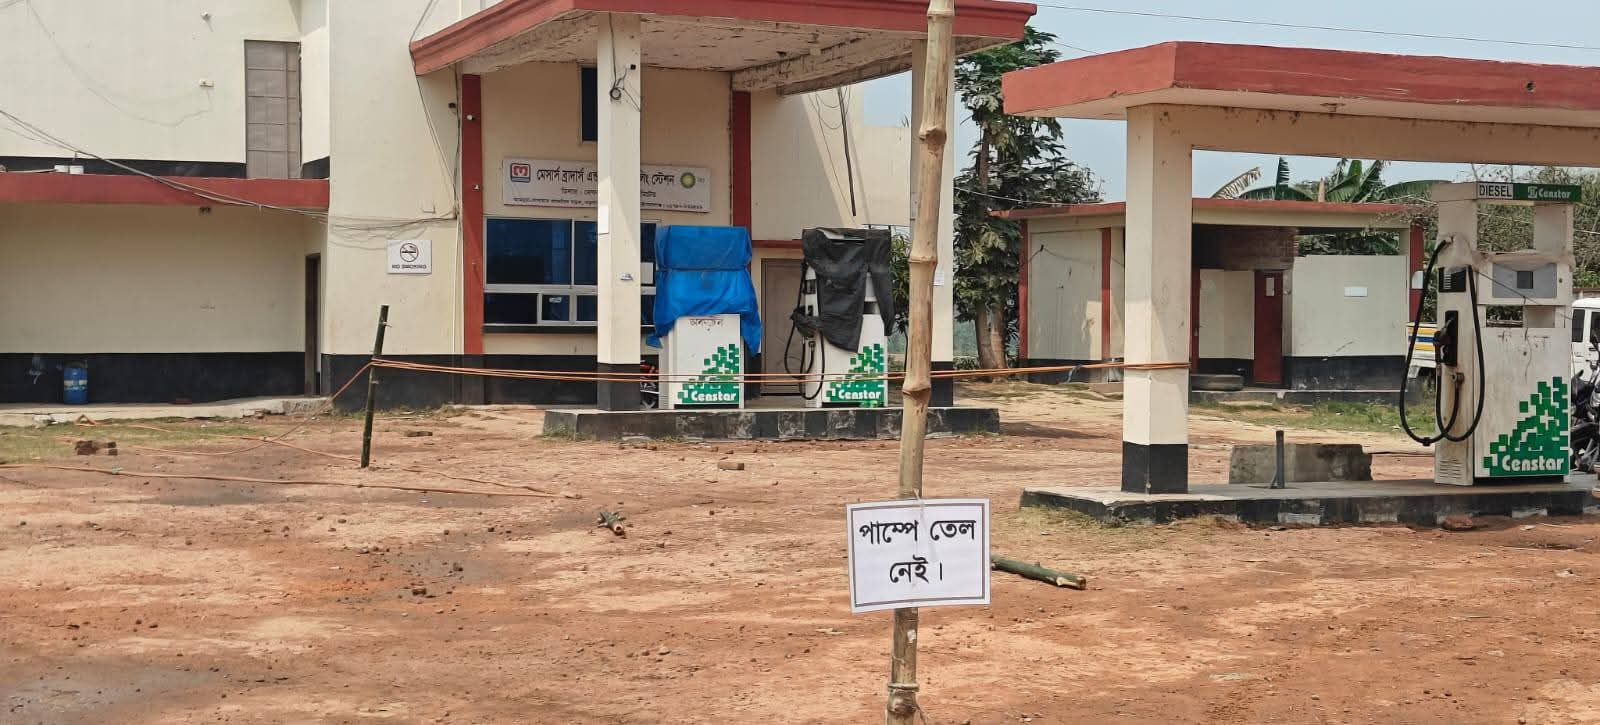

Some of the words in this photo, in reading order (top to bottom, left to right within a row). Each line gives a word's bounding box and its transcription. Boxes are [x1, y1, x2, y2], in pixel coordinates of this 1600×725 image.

[537, 166, 560, 182] মেসার্স
[652, 171, 675, 185] স্টেশন
[1479, 184, 1513, 198] DIESEL
[1539, 187, 1571, 199] Censtar
[691, 390, 737, 402] Censtar
[838, 389, 882, 400] Censtar
[1501, 454, 1565, 472] Censtar
[859, 519, 919, 545] পাম্পে
[930, 519, 977, 541] তেল
[889, 554, 930, 584] নেই
